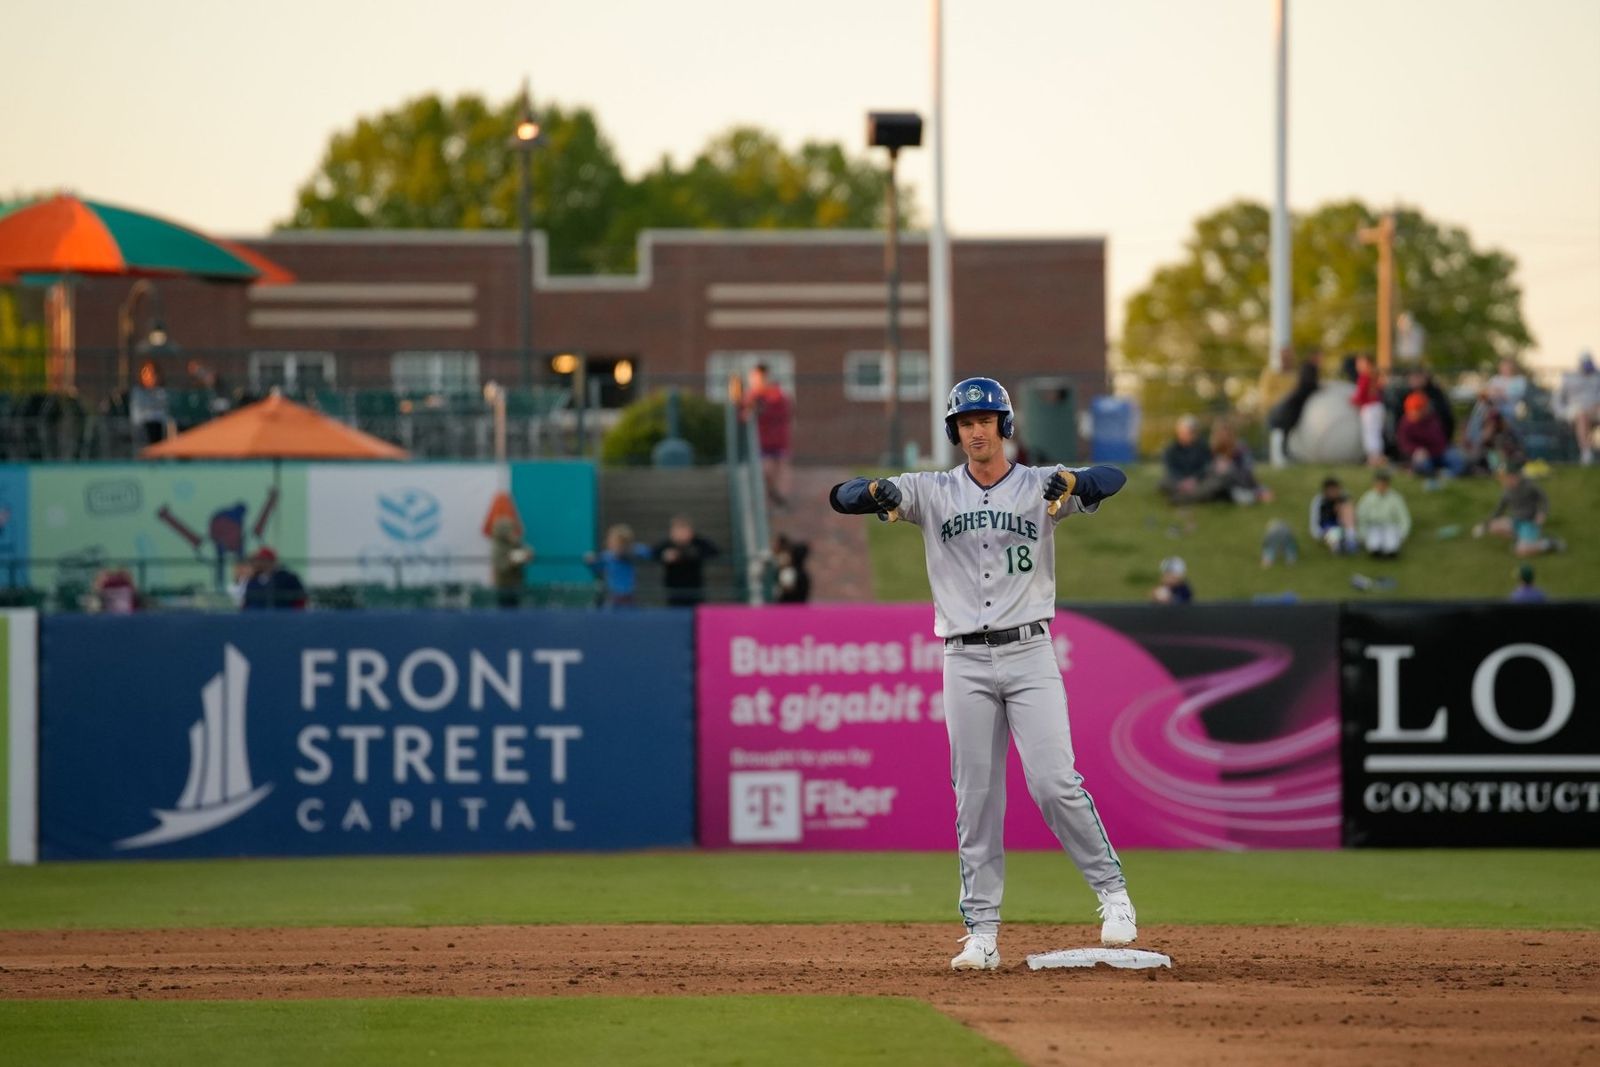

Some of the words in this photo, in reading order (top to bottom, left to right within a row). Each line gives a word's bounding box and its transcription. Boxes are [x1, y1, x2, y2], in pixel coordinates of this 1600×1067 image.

[941, 510, 1038, 542] ASHEVILLE
[1005, 545, 1034, 575] 18
[731, 635, 904, 676] Business
[300, 647, 583, 711] FRONT
[1363, 642, 1576, 745] LO
[731, 686, 773, 725] at
[779, 683, 923, 733] gigabit
[295, 725, 583, 784] STREET
[296, 798, 576, 832] CAPITAL
[804, 779, 897, 816] Fiber
[1363, 781, 1600, 813] CONSTRUCT
